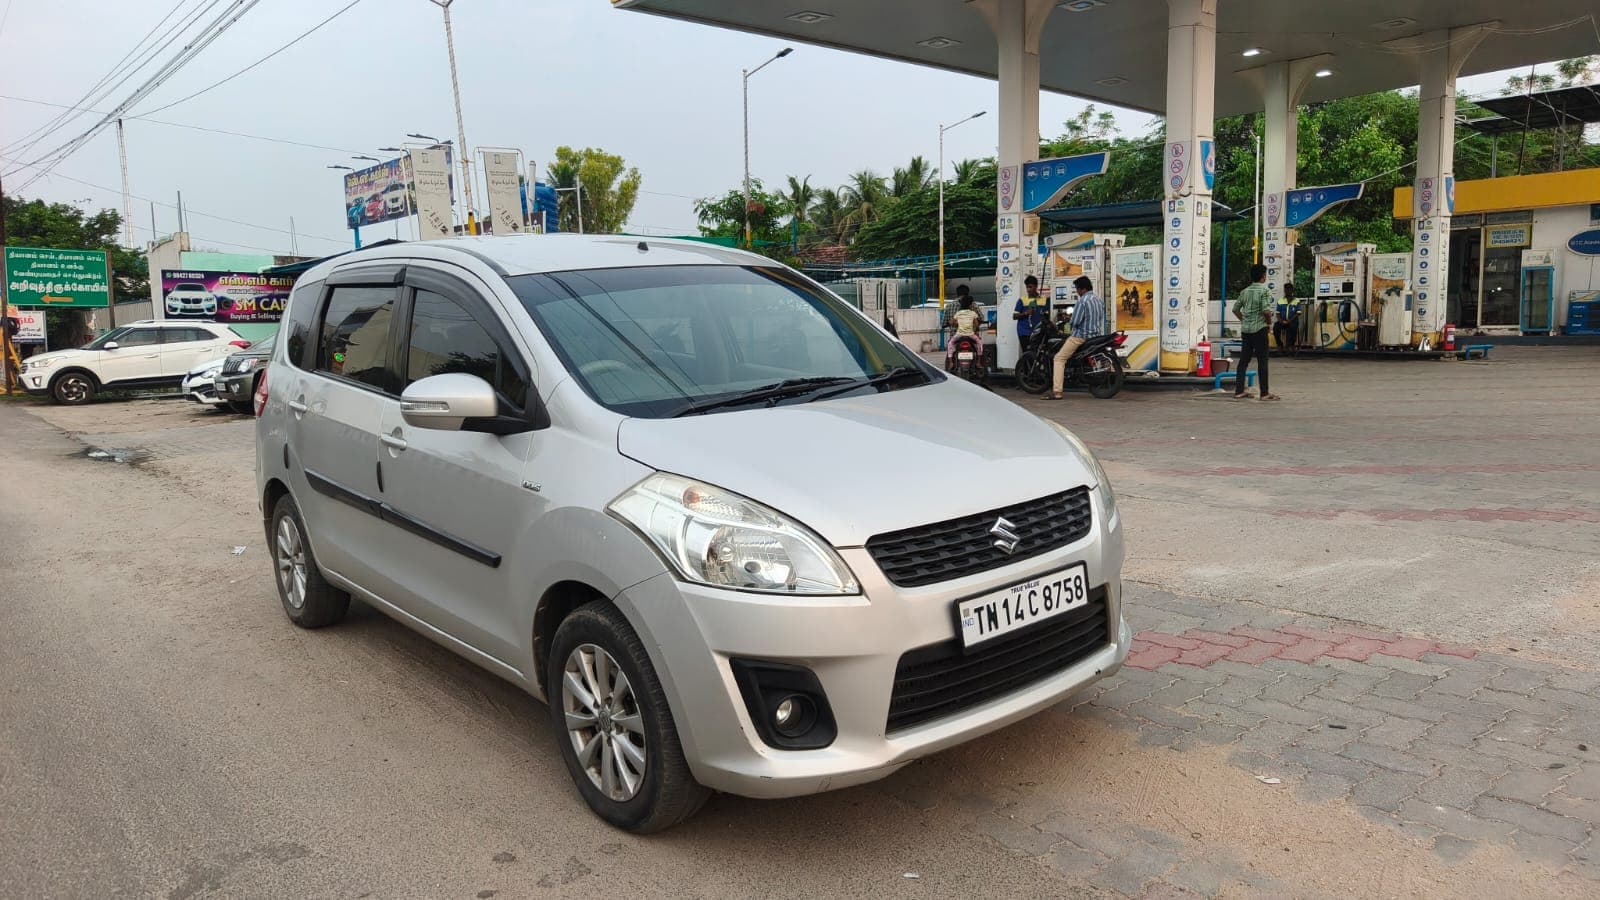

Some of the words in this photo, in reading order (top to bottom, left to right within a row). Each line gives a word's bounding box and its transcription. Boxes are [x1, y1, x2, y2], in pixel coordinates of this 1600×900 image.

[1030, 189, 1034, 201] 1
[1292, 211, 1298, 220] 3
[10, 280, 109, 294] அறிவுத்திருக்கோயில்
[235, 298, 256, 311] SM
[257, 312, 276, 320] Selling
[1010, 586, 1024, 595] TRUE
[1024, 580, 1040, 591] VALUE
[974, 602, 999, 635] TN
[1002, 594, 1025, 626] 14
[1028, 589, 1039, 617] C
[1042, 574, 1084, 612] 8758
[962, 617, 975, 628] IND
